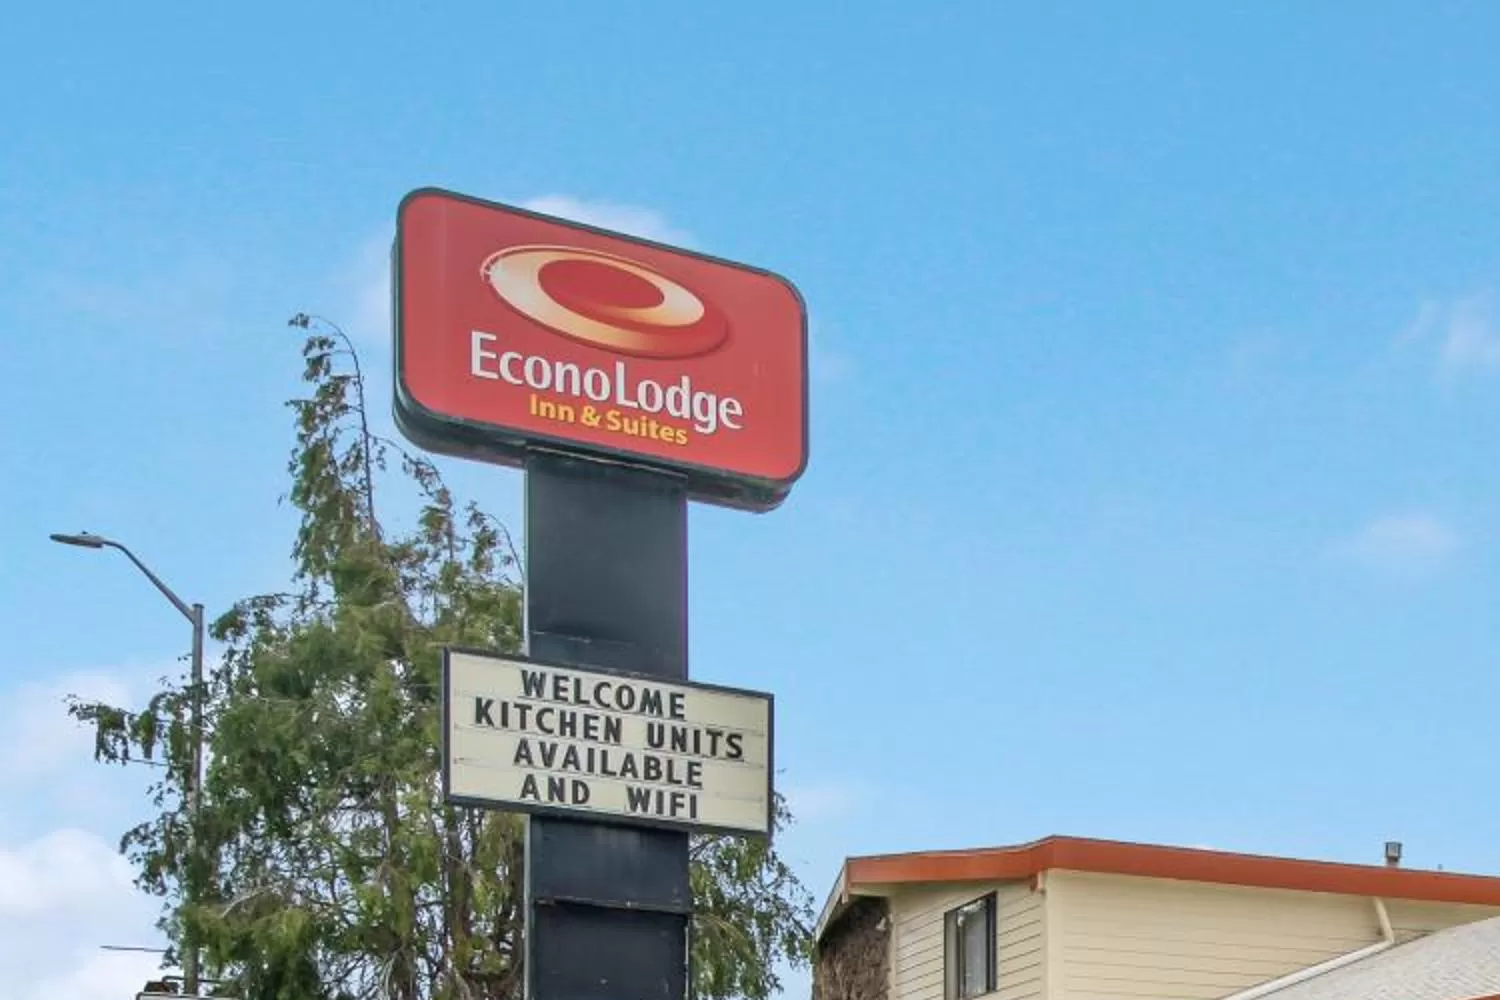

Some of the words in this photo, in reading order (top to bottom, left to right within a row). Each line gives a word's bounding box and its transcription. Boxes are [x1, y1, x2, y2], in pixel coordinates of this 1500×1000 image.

[530, 393, 575, 423] Inn
[580, 405, 602, 427] &
[605, 409, 688, 445] Suites
[521, 669, 685, 720] WELCOME
[475, 697, 622, 744] KITCHEN
[647, 722, 743, 759] UNITS
[514, 738, 703, 787] AVAILABLE
[520, 773, 590, 805] AND
[626, 785, 697, 819] WIFI
